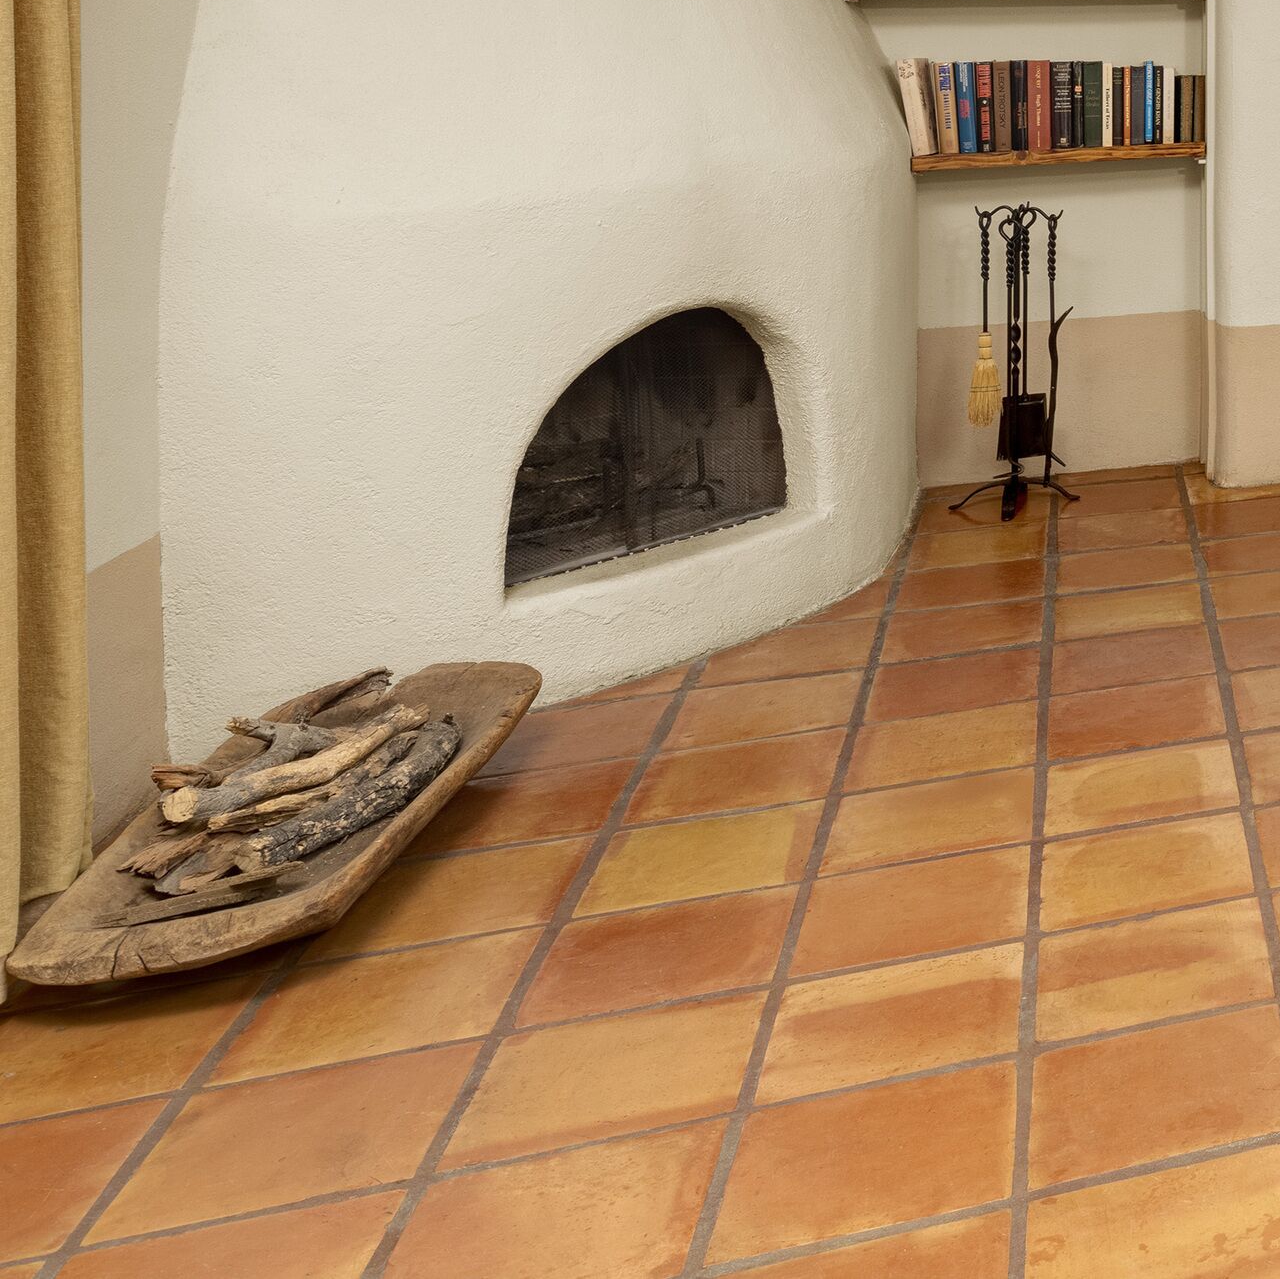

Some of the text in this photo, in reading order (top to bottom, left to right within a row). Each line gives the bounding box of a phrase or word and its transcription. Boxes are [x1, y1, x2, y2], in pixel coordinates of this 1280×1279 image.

[939, 64, 950, 75] THE
[939, 75, 952, 92] PRIZE
[944, 112, 952, 130] YERGIN
